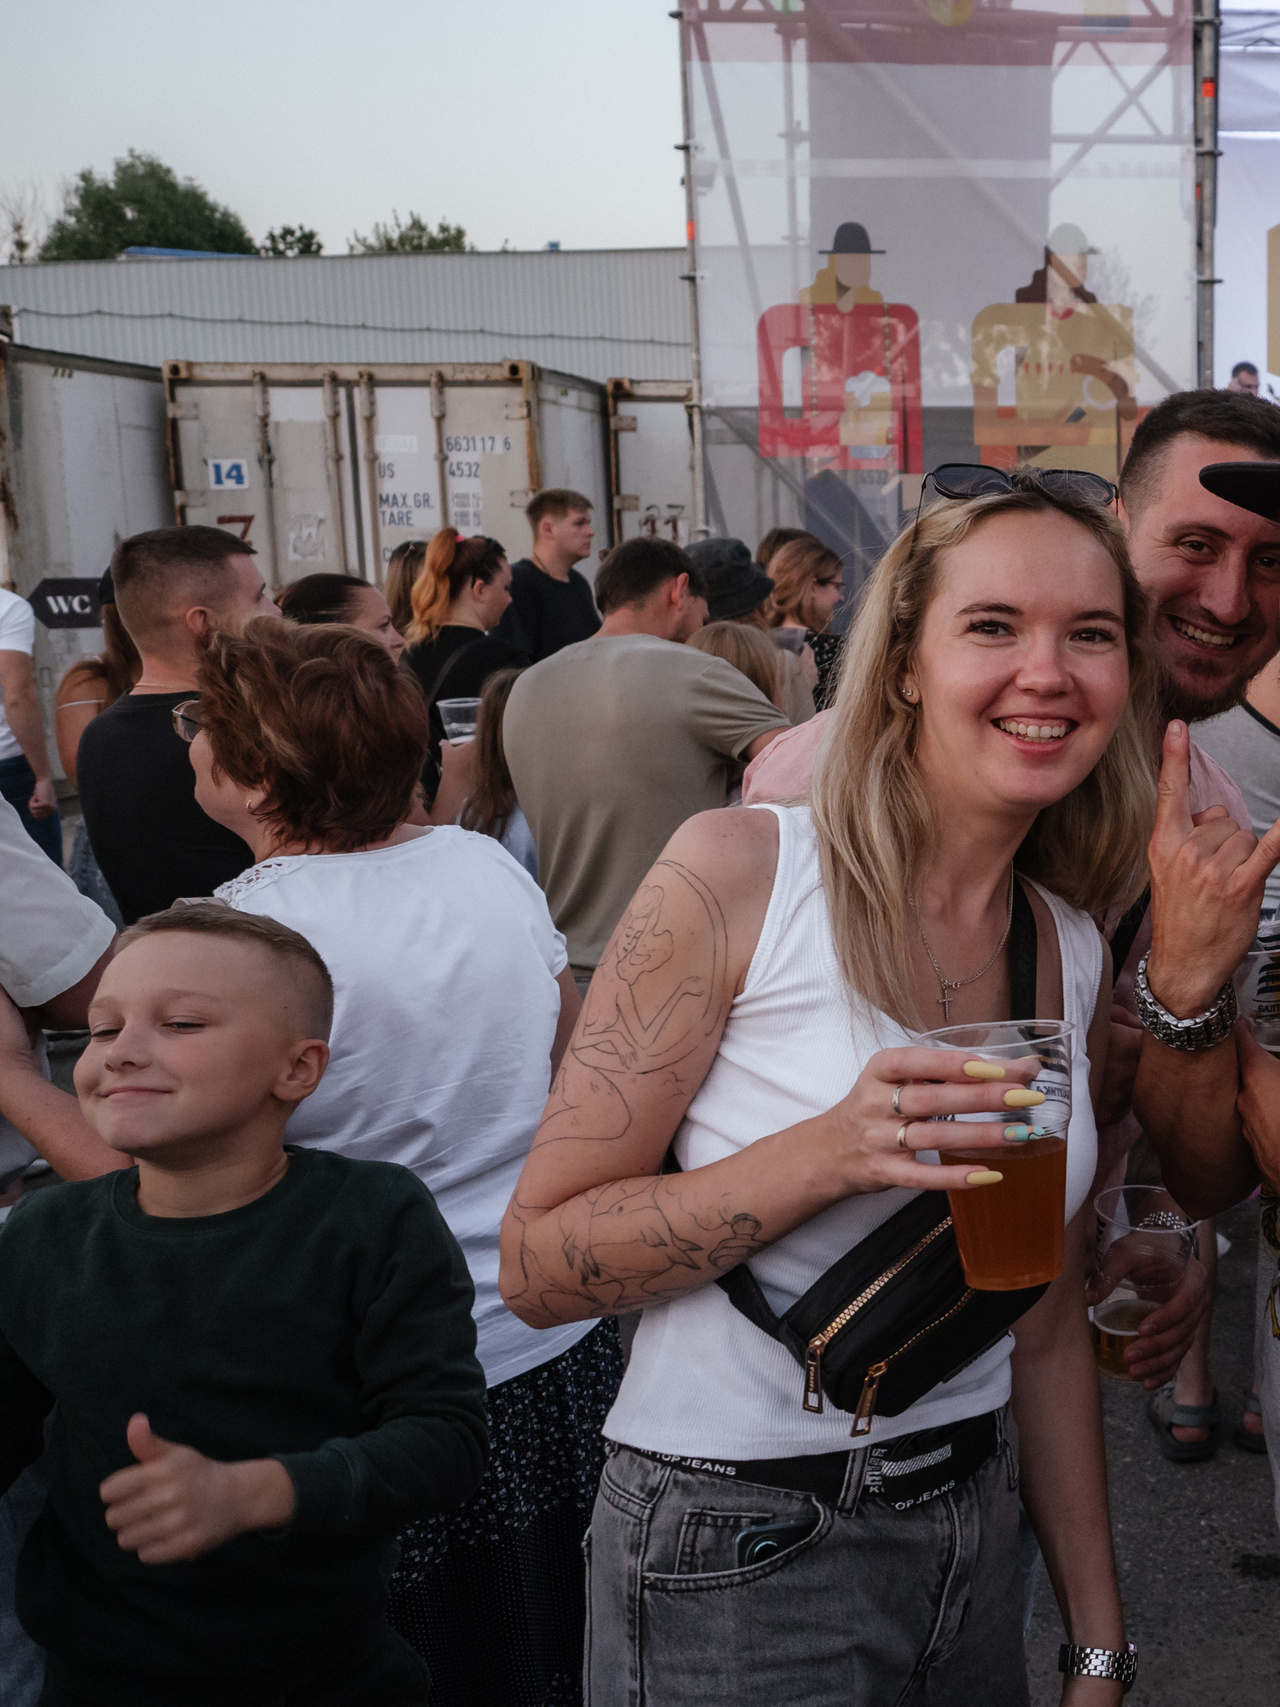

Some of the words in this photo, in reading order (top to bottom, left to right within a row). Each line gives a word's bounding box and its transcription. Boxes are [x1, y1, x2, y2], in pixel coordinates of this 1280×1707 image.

[212, 462, 245, 485] 14
[378, 462, 395, 479] US
[448, 461, 480, 478] 4532
[379, 510, 414, 527] TARE
[45, 594, 92, 615] WC
[681, 1457, 737, 1476] JEANS
[915, 1479, 956, 1505] JEANS
